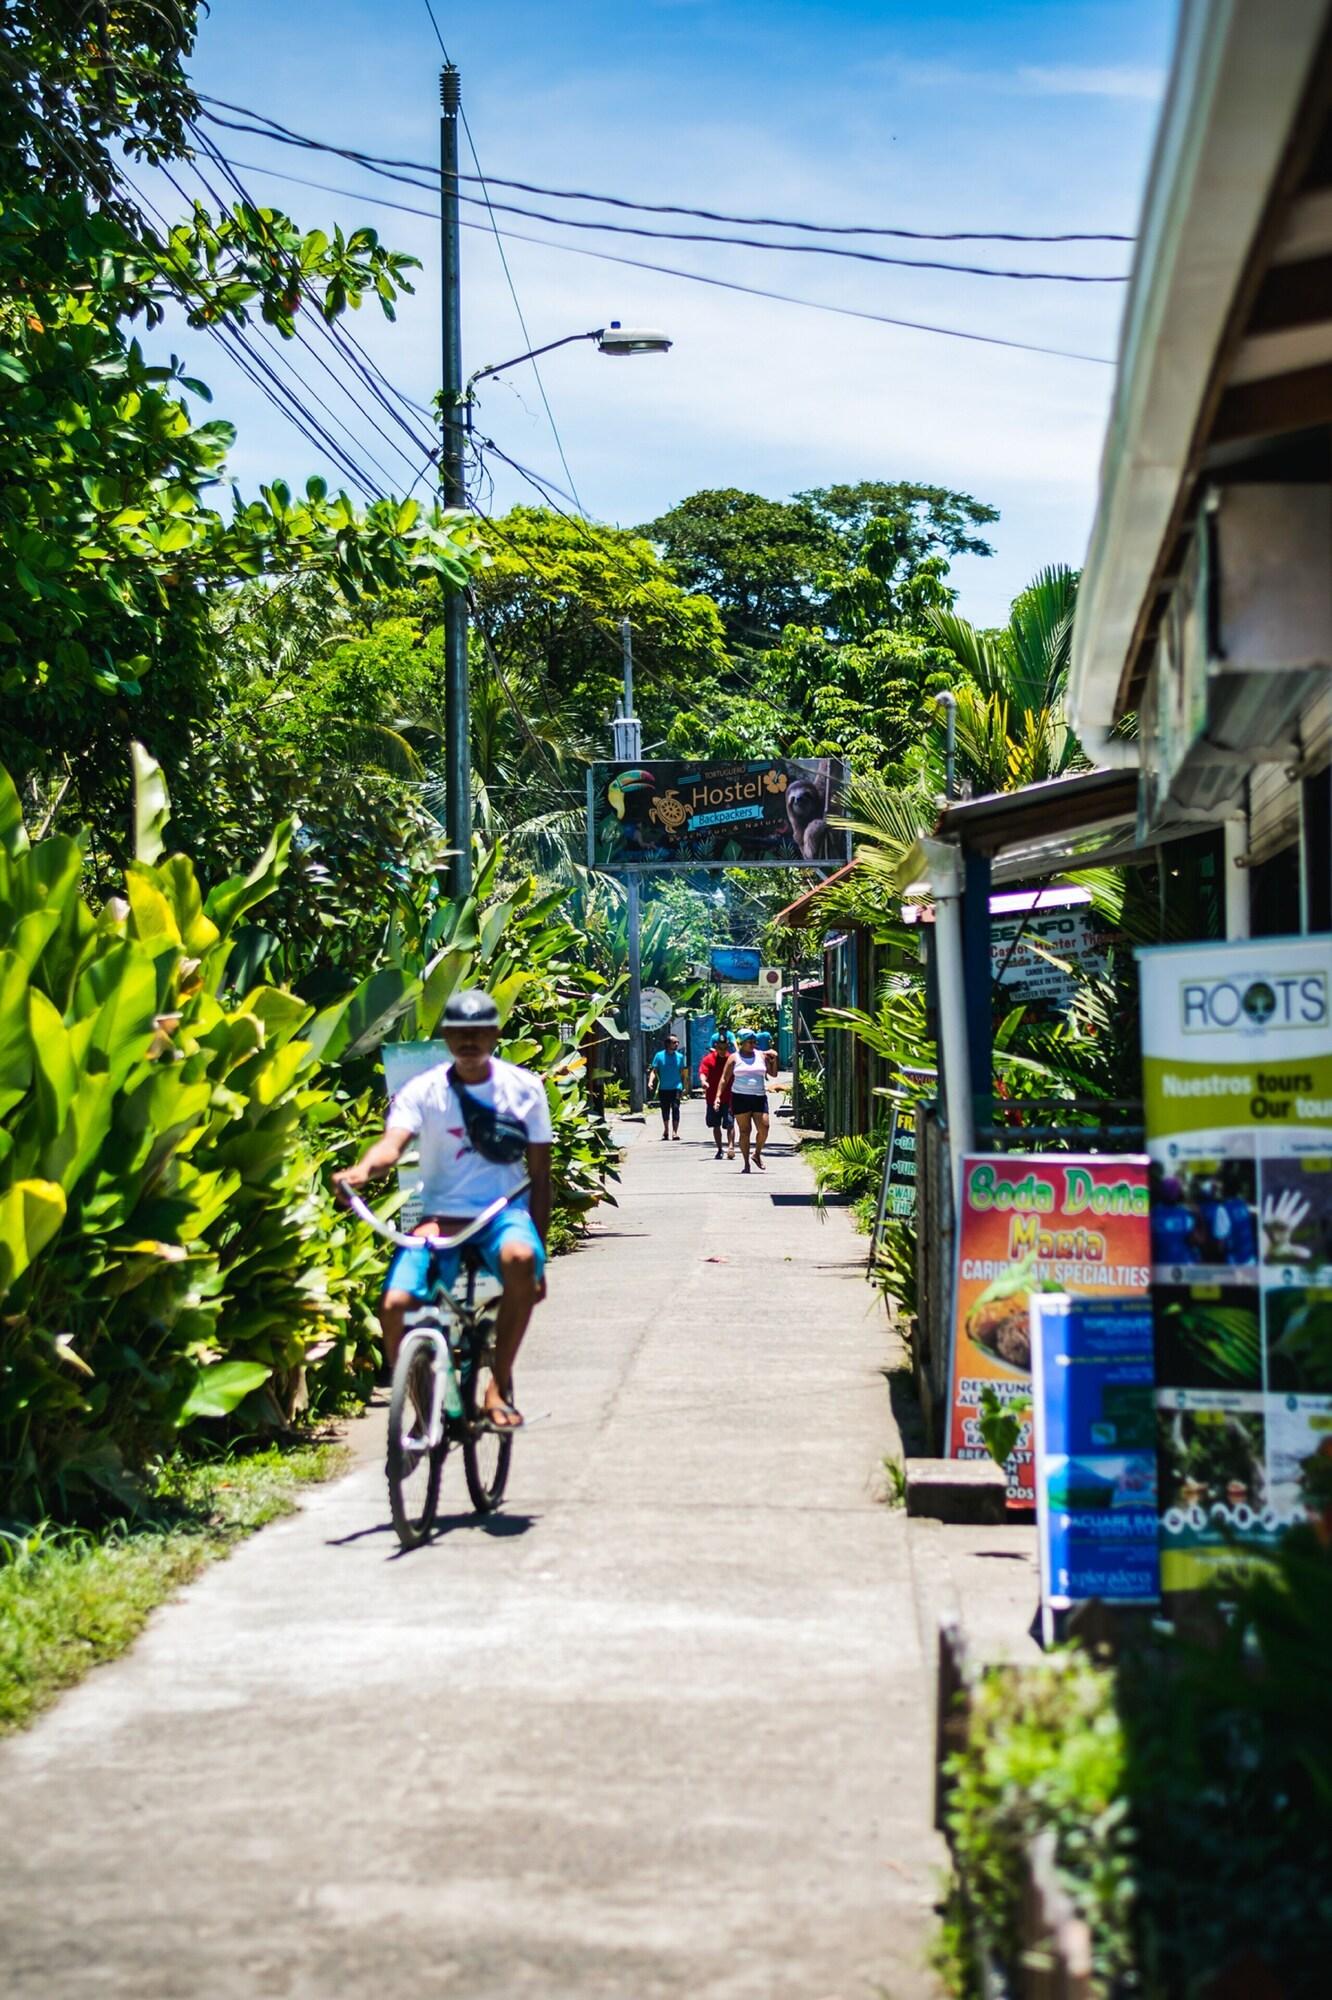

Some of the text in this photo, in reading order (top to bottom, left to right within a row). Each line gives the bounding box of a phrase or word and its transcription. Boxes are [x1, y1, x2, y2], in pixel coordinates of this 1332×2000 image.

[692, 775, 763, 808] Hostel
[698, 807, 753, 825] Backpackers
[1020, 919, 1075, 938] NFO
[1183, 978, 1326, 1027] ROOTS
[1163, 1072, 1313, 1097] Nuestros tours
[1250, 1096, 1332, 1119] Our tou
[895, 1186, 915, 1200] WAL
[969, 1164, 1054, 1213] Soda
[1054, 1263, 1150, 1288] SPECIALTIES
[957, 1448, 1033, 1463] BREAAST
